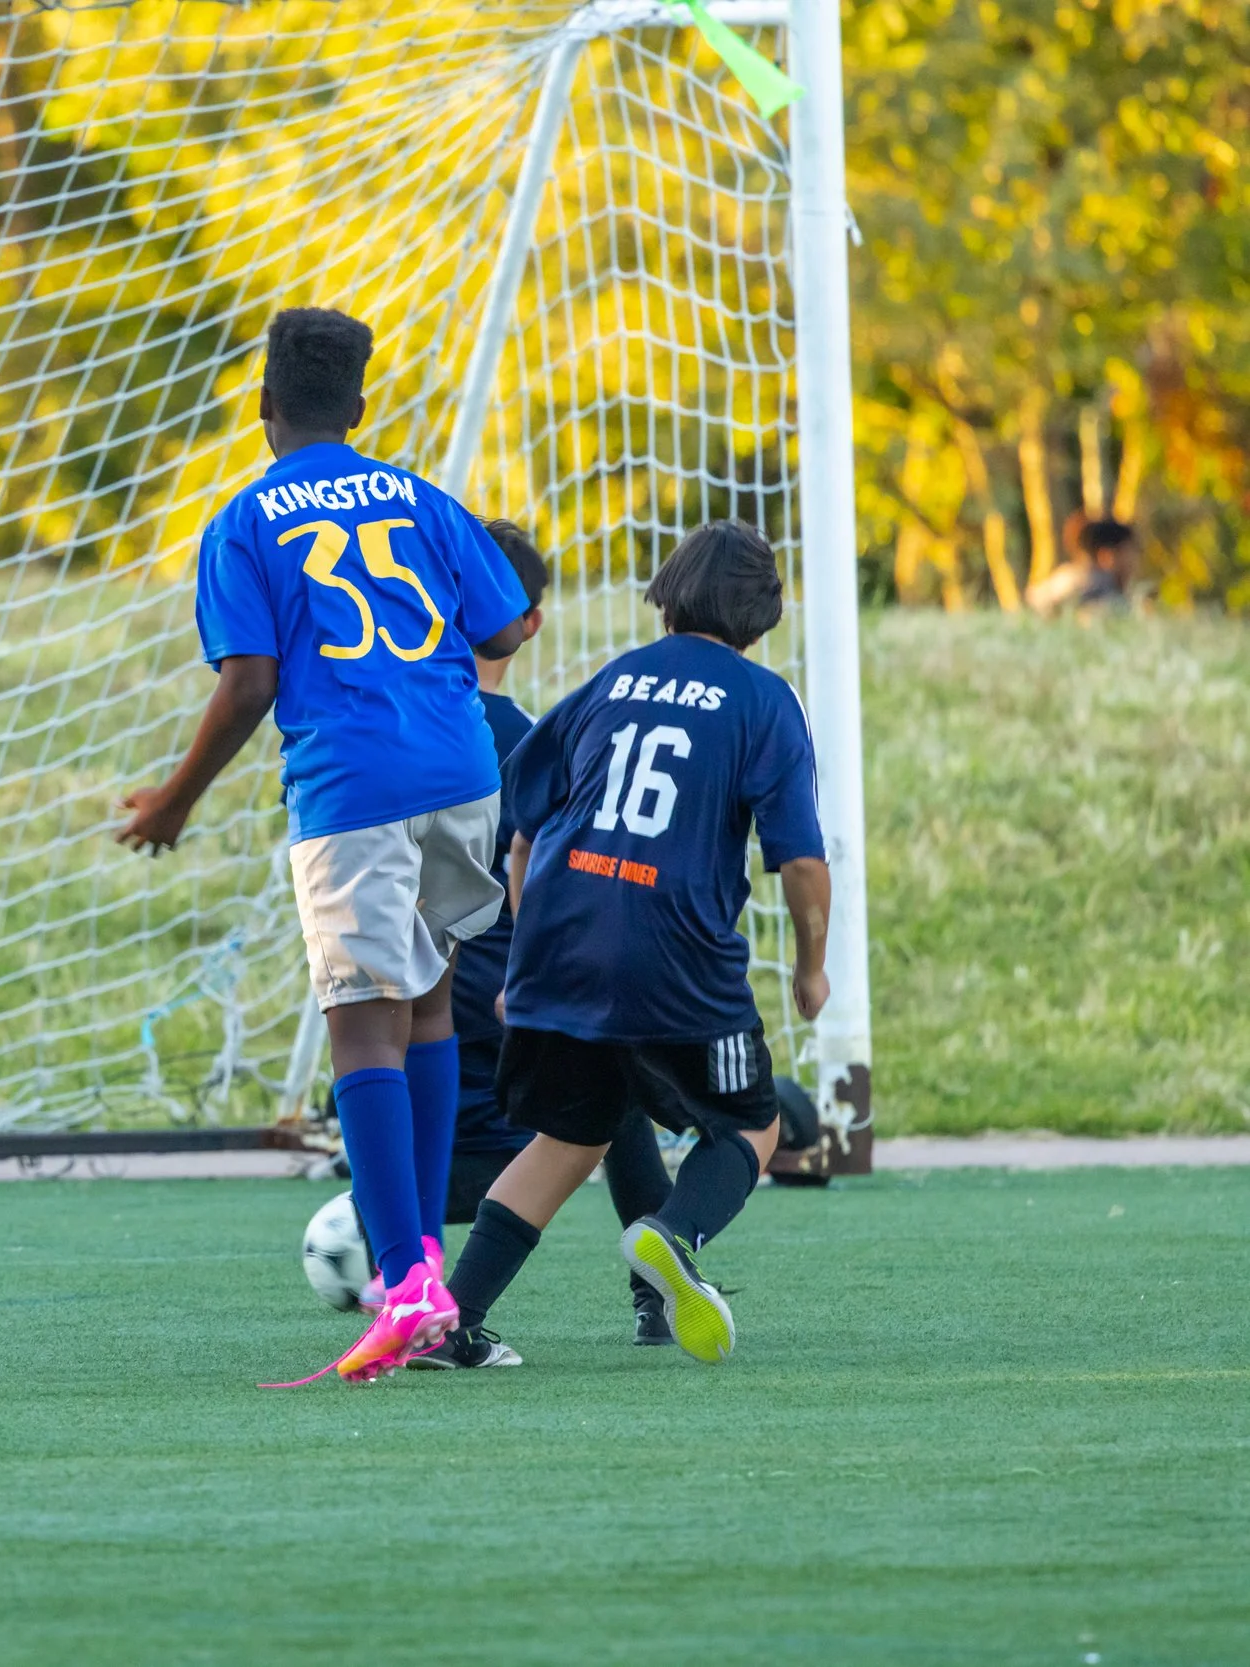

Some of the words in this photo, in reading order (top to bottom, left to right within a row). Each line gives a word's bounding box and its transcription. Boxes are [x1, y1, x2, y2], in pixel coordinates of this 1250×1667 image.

[256, 471, 417, 521] KINGSTON
[277, 518, 445, 661] 35
[609, 674, 727, 711] BEARS
[593, 722, 692, 838] 16
[568, 848, 618, 878] SUNRISE
